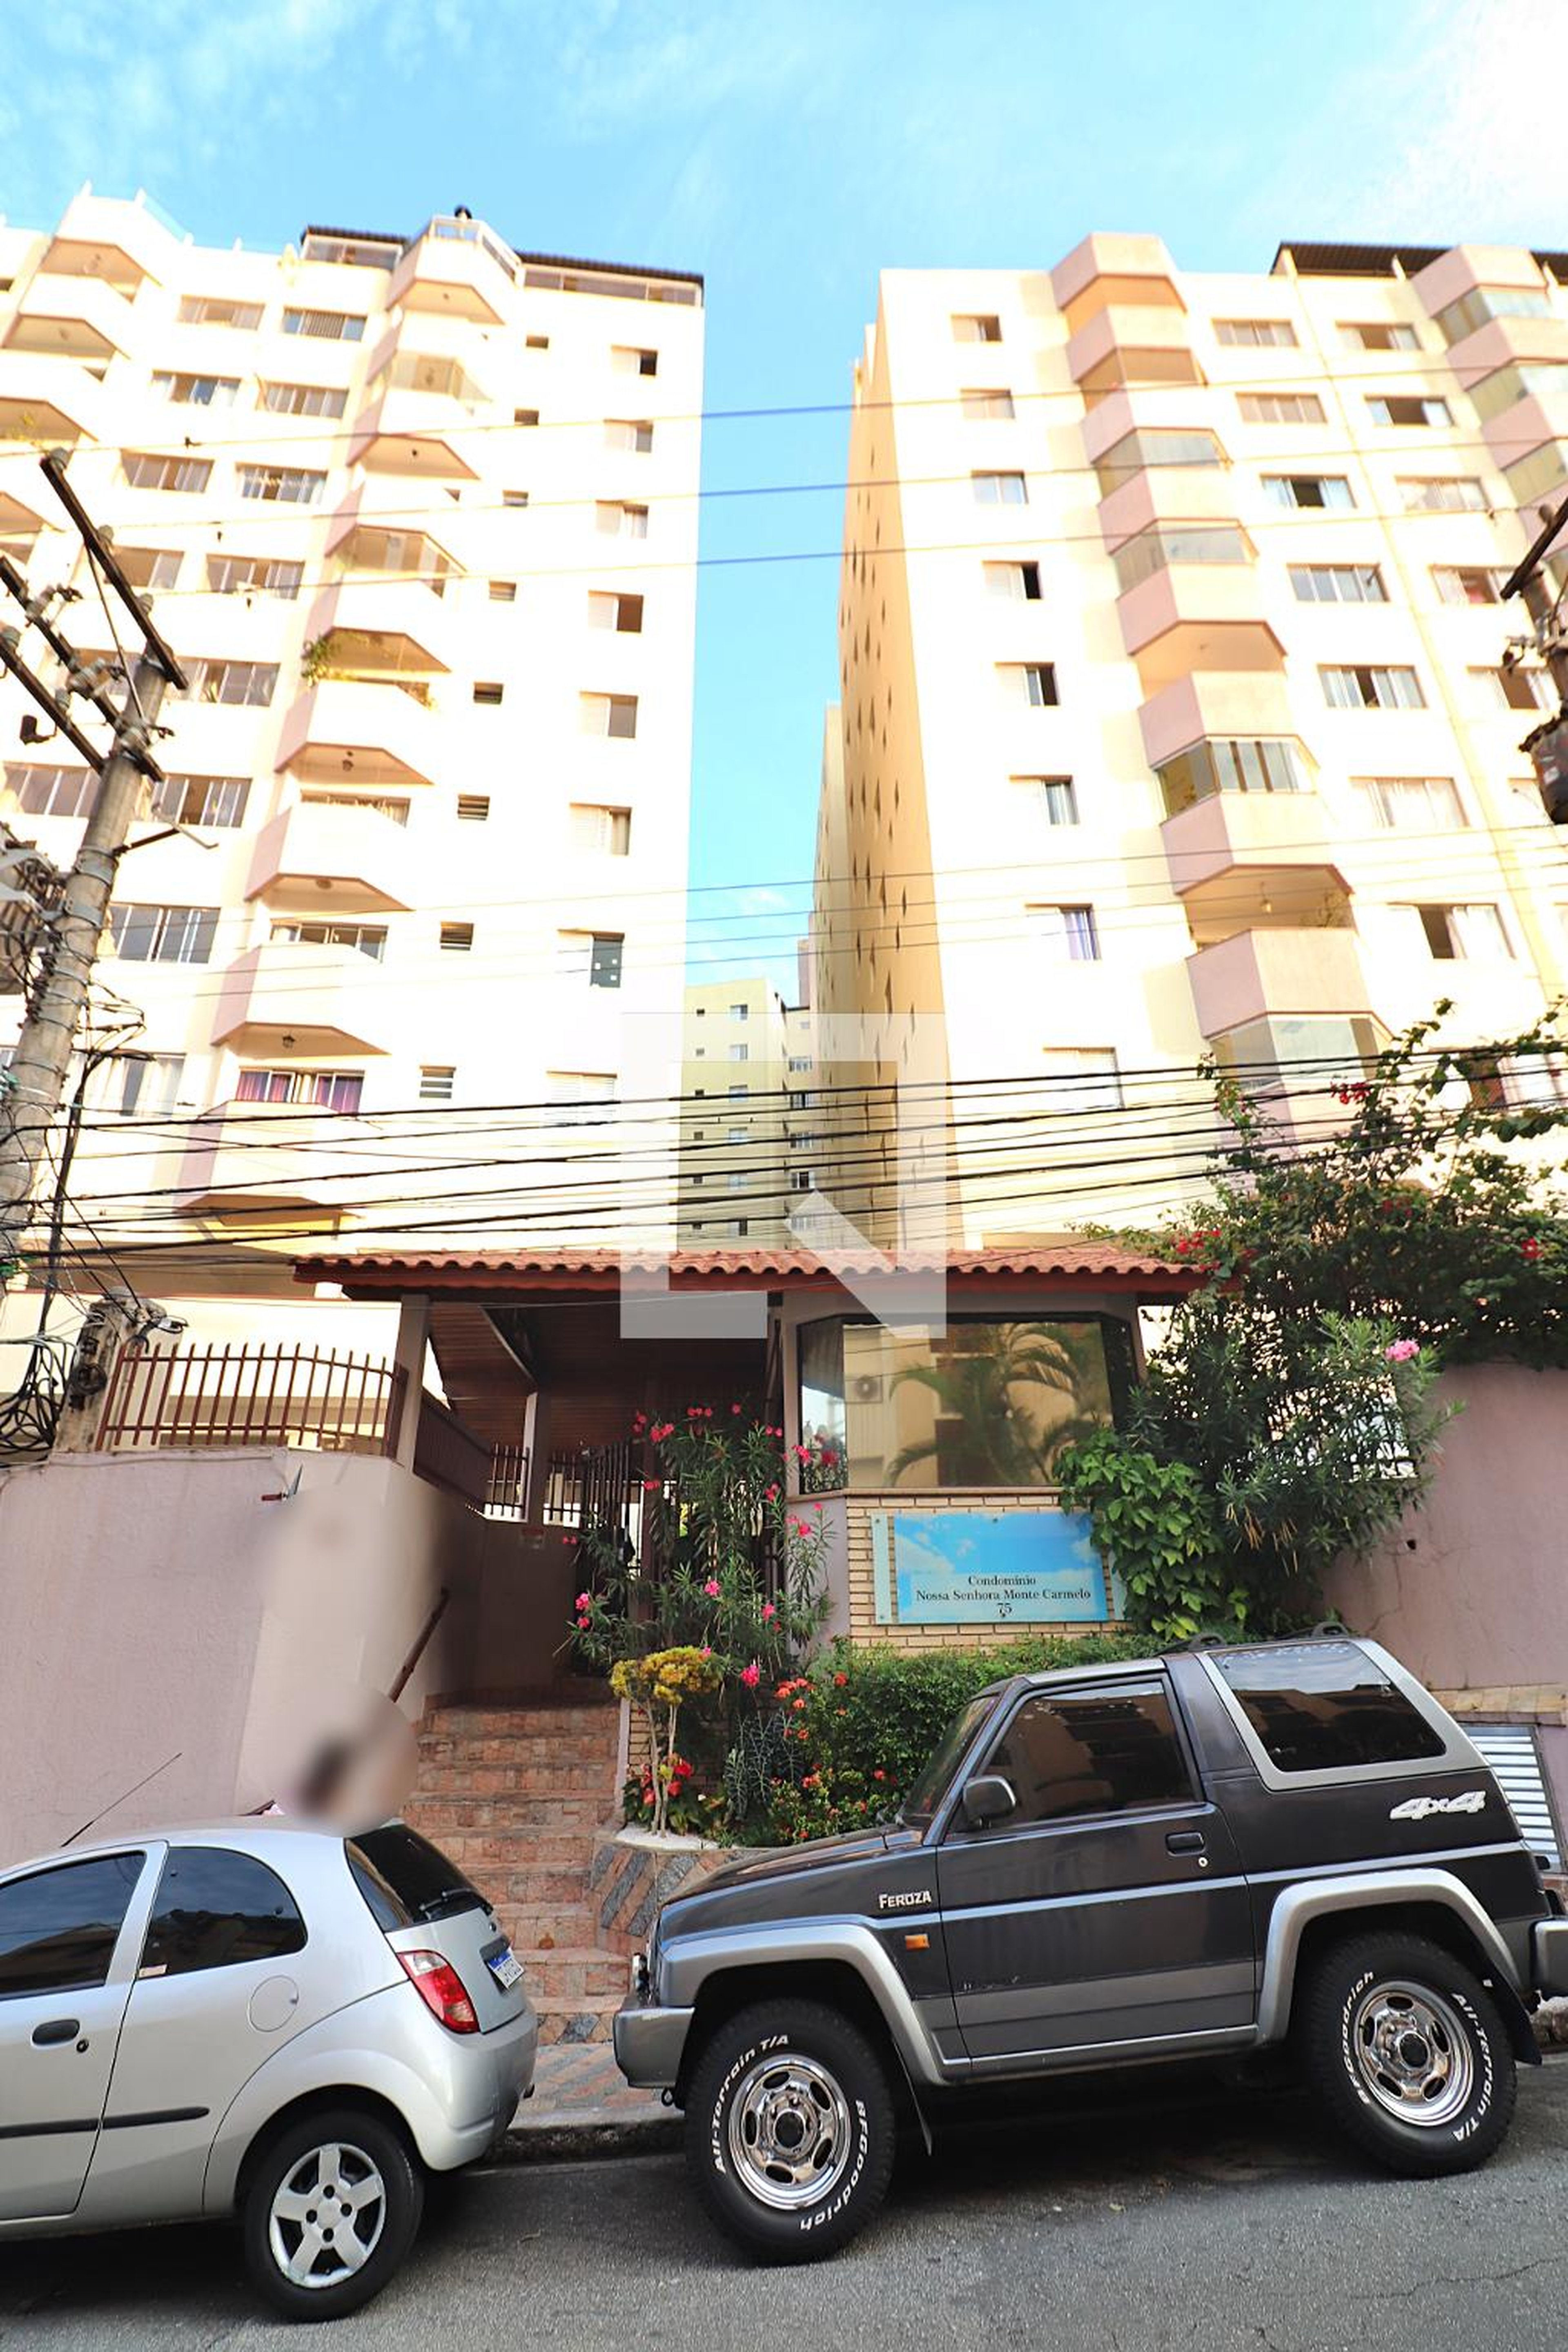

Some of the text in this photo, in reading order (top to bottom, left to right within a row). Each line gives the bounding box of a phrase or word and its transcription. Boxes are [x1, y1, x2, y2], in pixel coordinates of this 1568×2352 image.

[916, 1588, 1091, 1600] Nossa Senhora Monte Carmelo
[997, 1603, 1012, 1614] 75
[1390, 1791, 1486, 1820] 4x4
[712, 2035, 789, 2174] All-Terrain T/A
[800, 2100, 868, 2231] BFGoodrich
